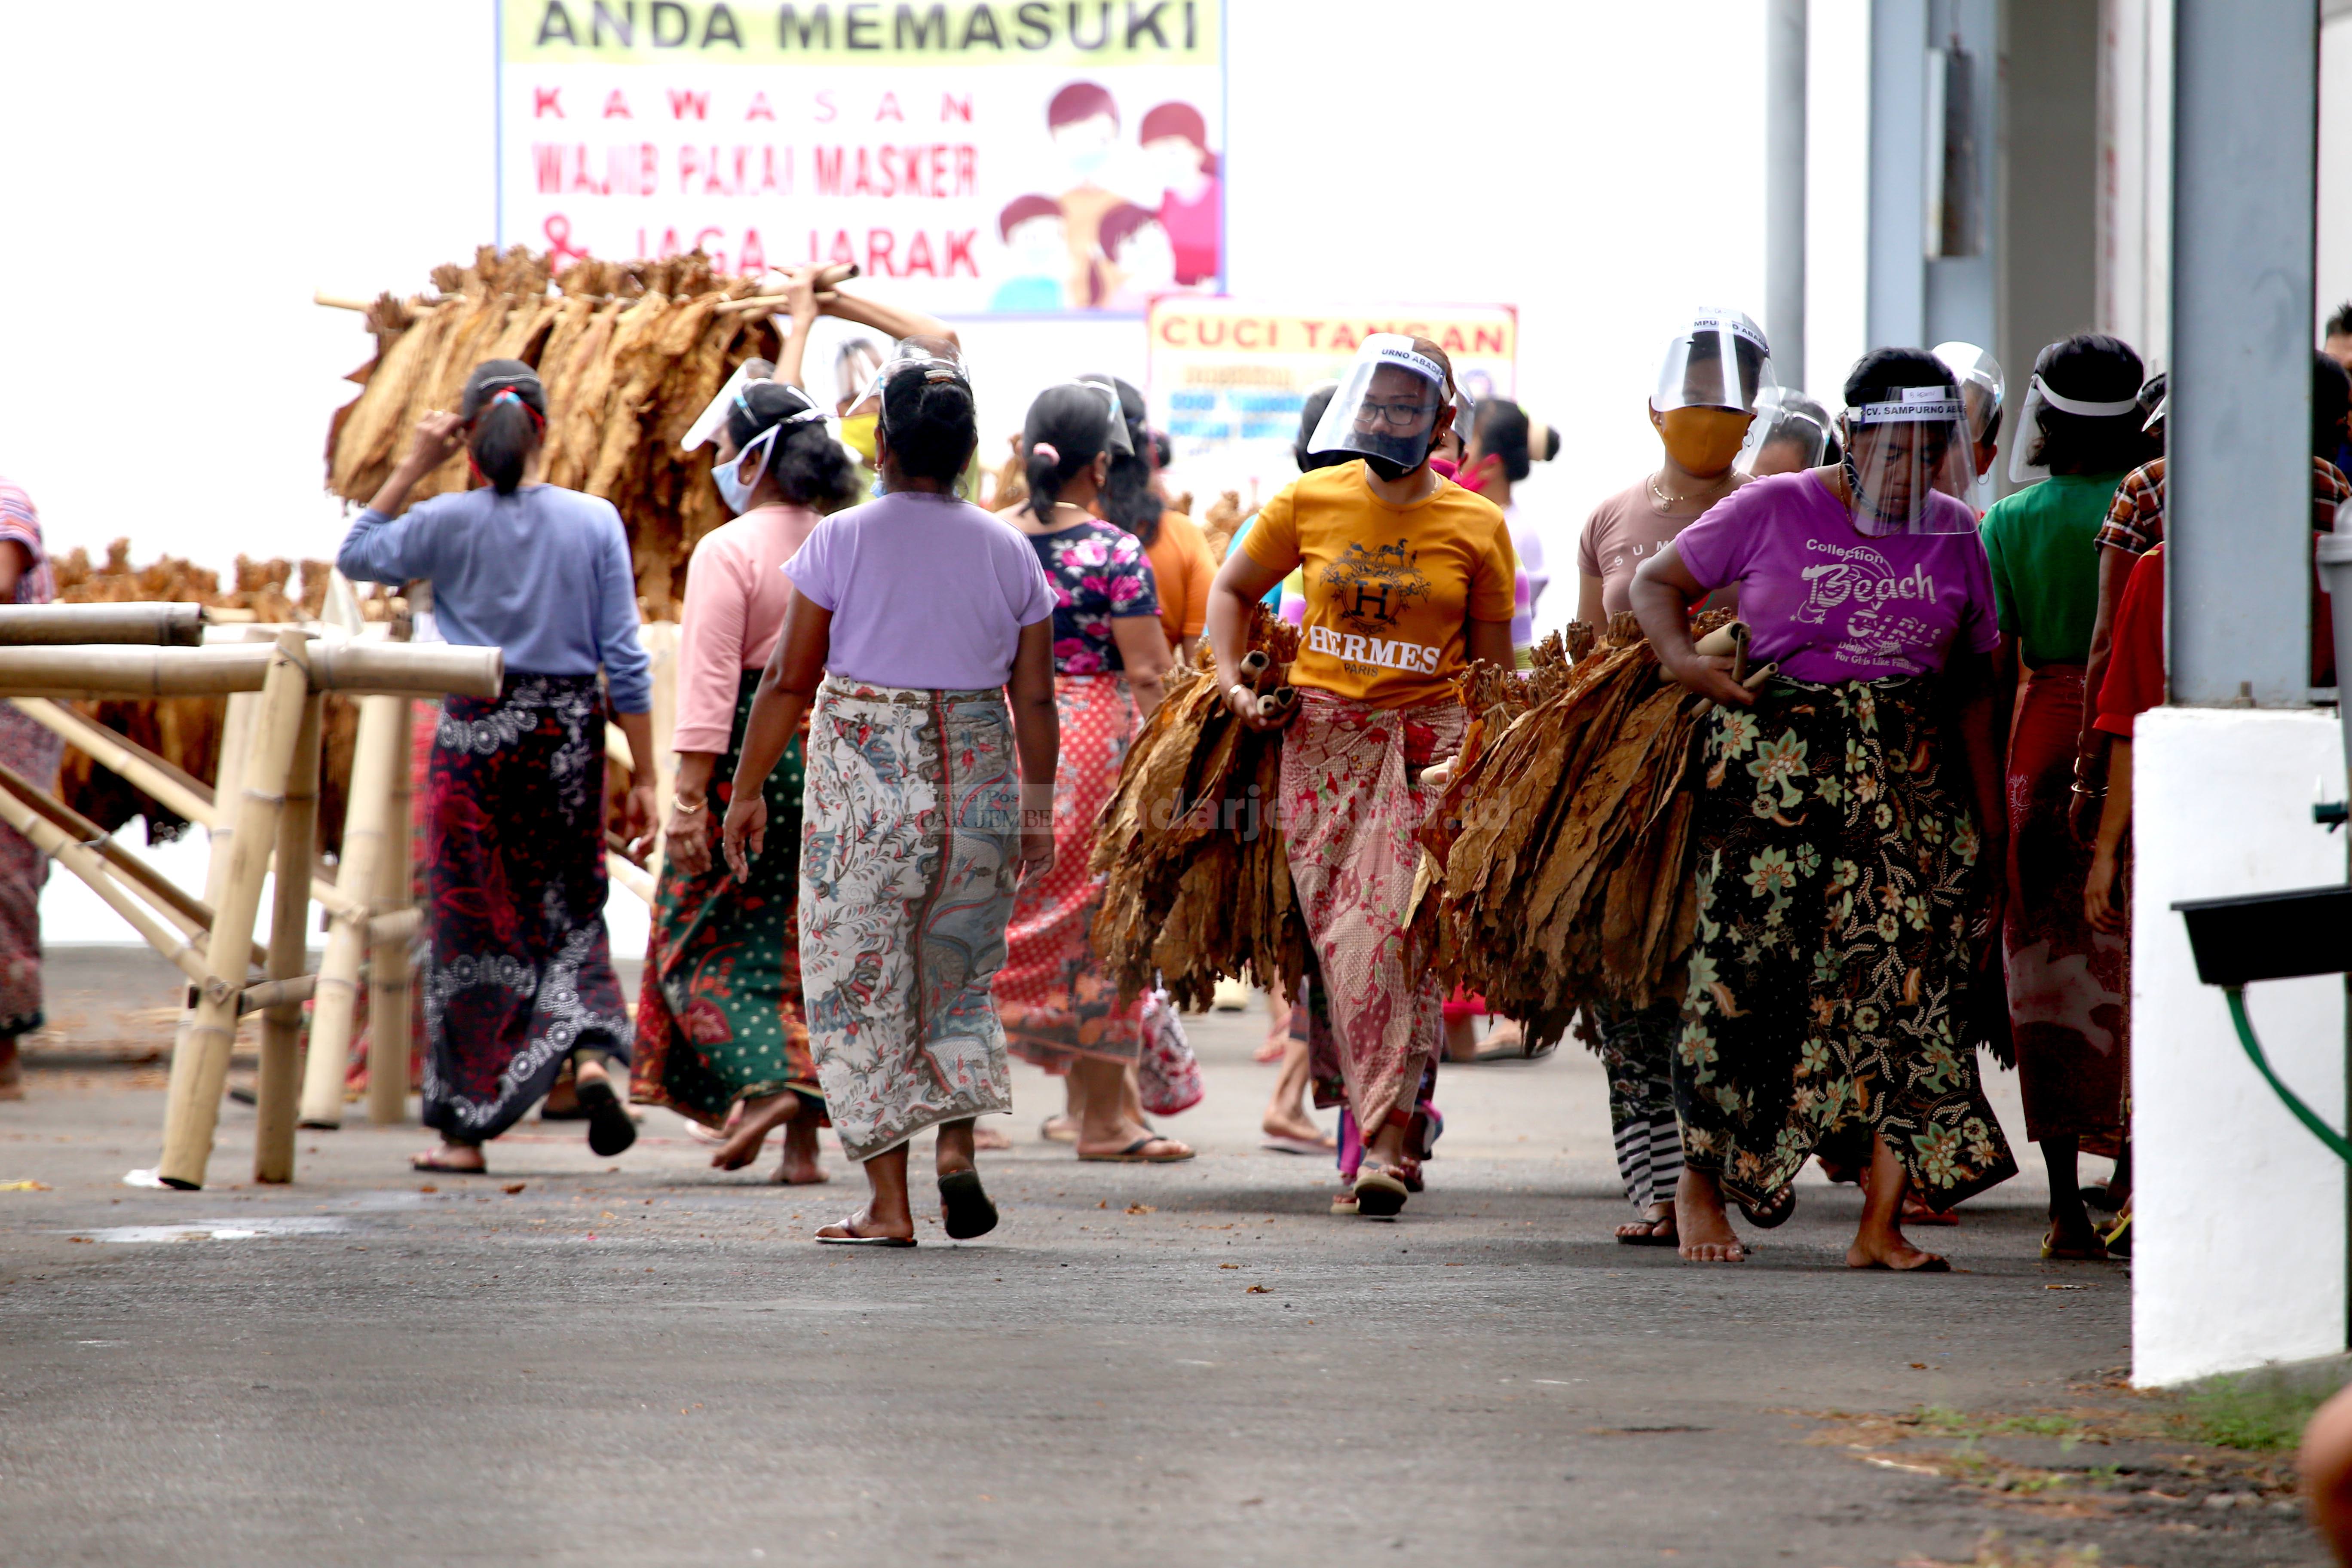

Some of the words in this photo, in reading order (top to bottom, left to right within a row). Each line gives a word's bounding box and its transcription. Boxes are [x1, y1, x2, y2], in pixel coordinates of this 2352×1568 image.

[536, 1, 743, 49] ANDA
[779, 1, 1196, 51] MEMASUKI
[813, 143, 979, 198] MASKER
[543, 214, 589, 275] &
[1162, 317, 1279, 348] CUCI
[1412, 356, 1439, 376] ABADI
[1884, 405, 1944, 415] SAMPURNO
[1806, 538, 1884, 564] Collection
[1351, 580, 1393, 620] H
[1801, 563, 1937, 608] Beach
[1308, 625, 1440, 675] HERMES
[1835, 651, 1849, 663] For
[1872, 657, 1890, 666] Like
[1838, 641, 1868, 655] Design
[1344, 662, 1378, 677] PARIS
